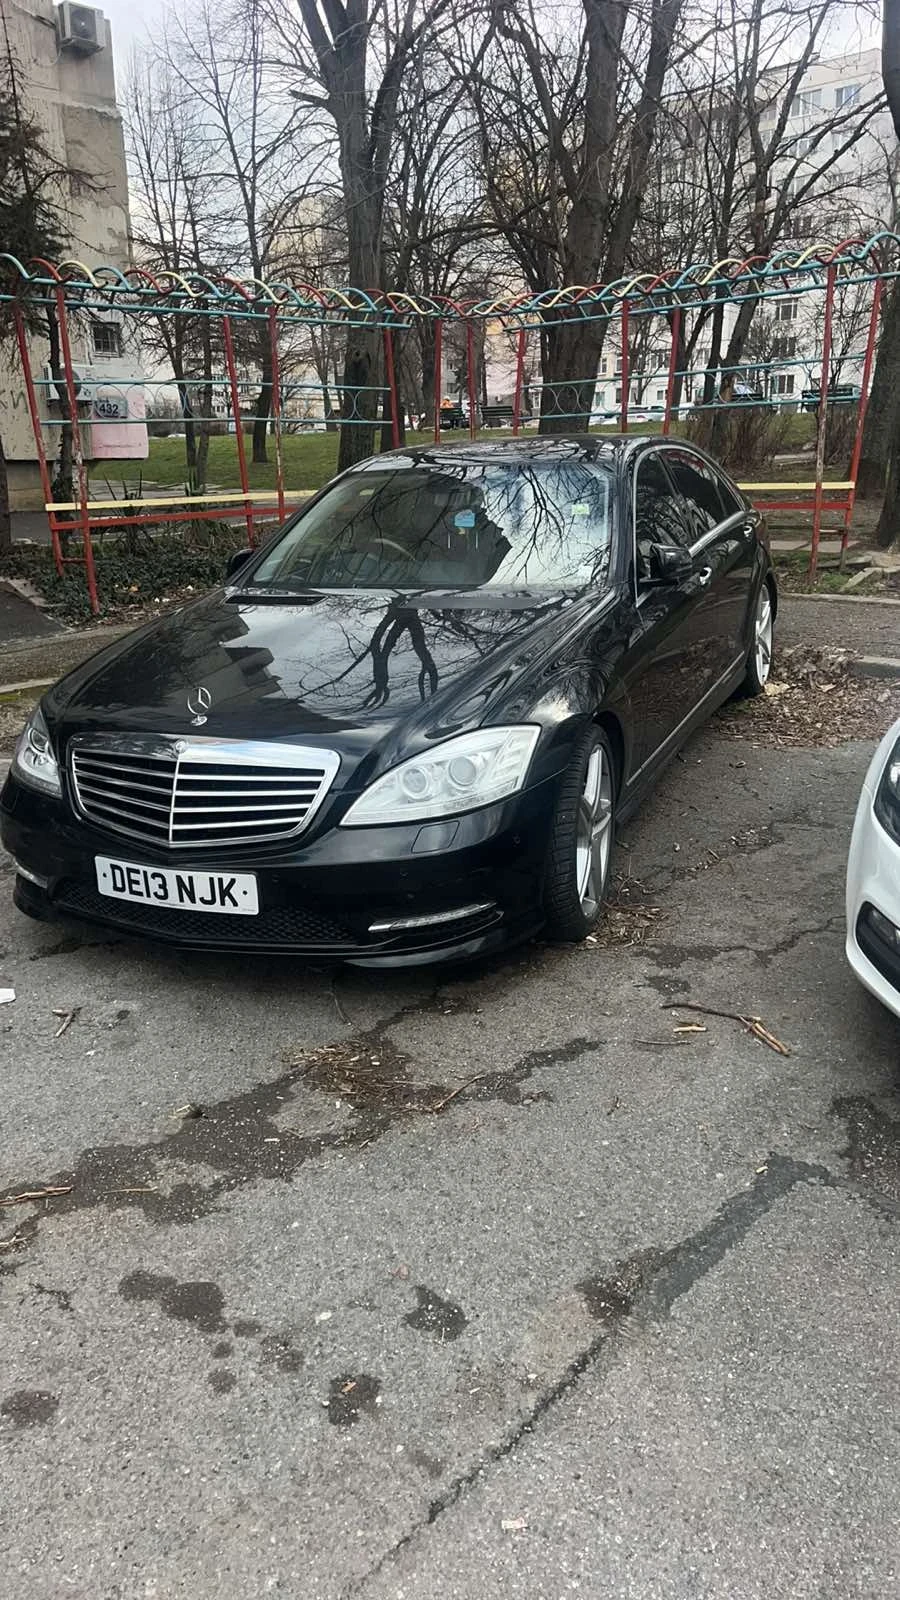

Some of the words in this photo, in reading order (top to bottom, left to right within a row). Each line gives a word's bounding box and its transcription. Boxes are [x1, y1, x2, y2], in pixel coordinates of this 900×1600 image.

[99, 403, 119, 414] 432
[110, 863, 169, 900] DE13
[175, 875, 239, 907] NJK
